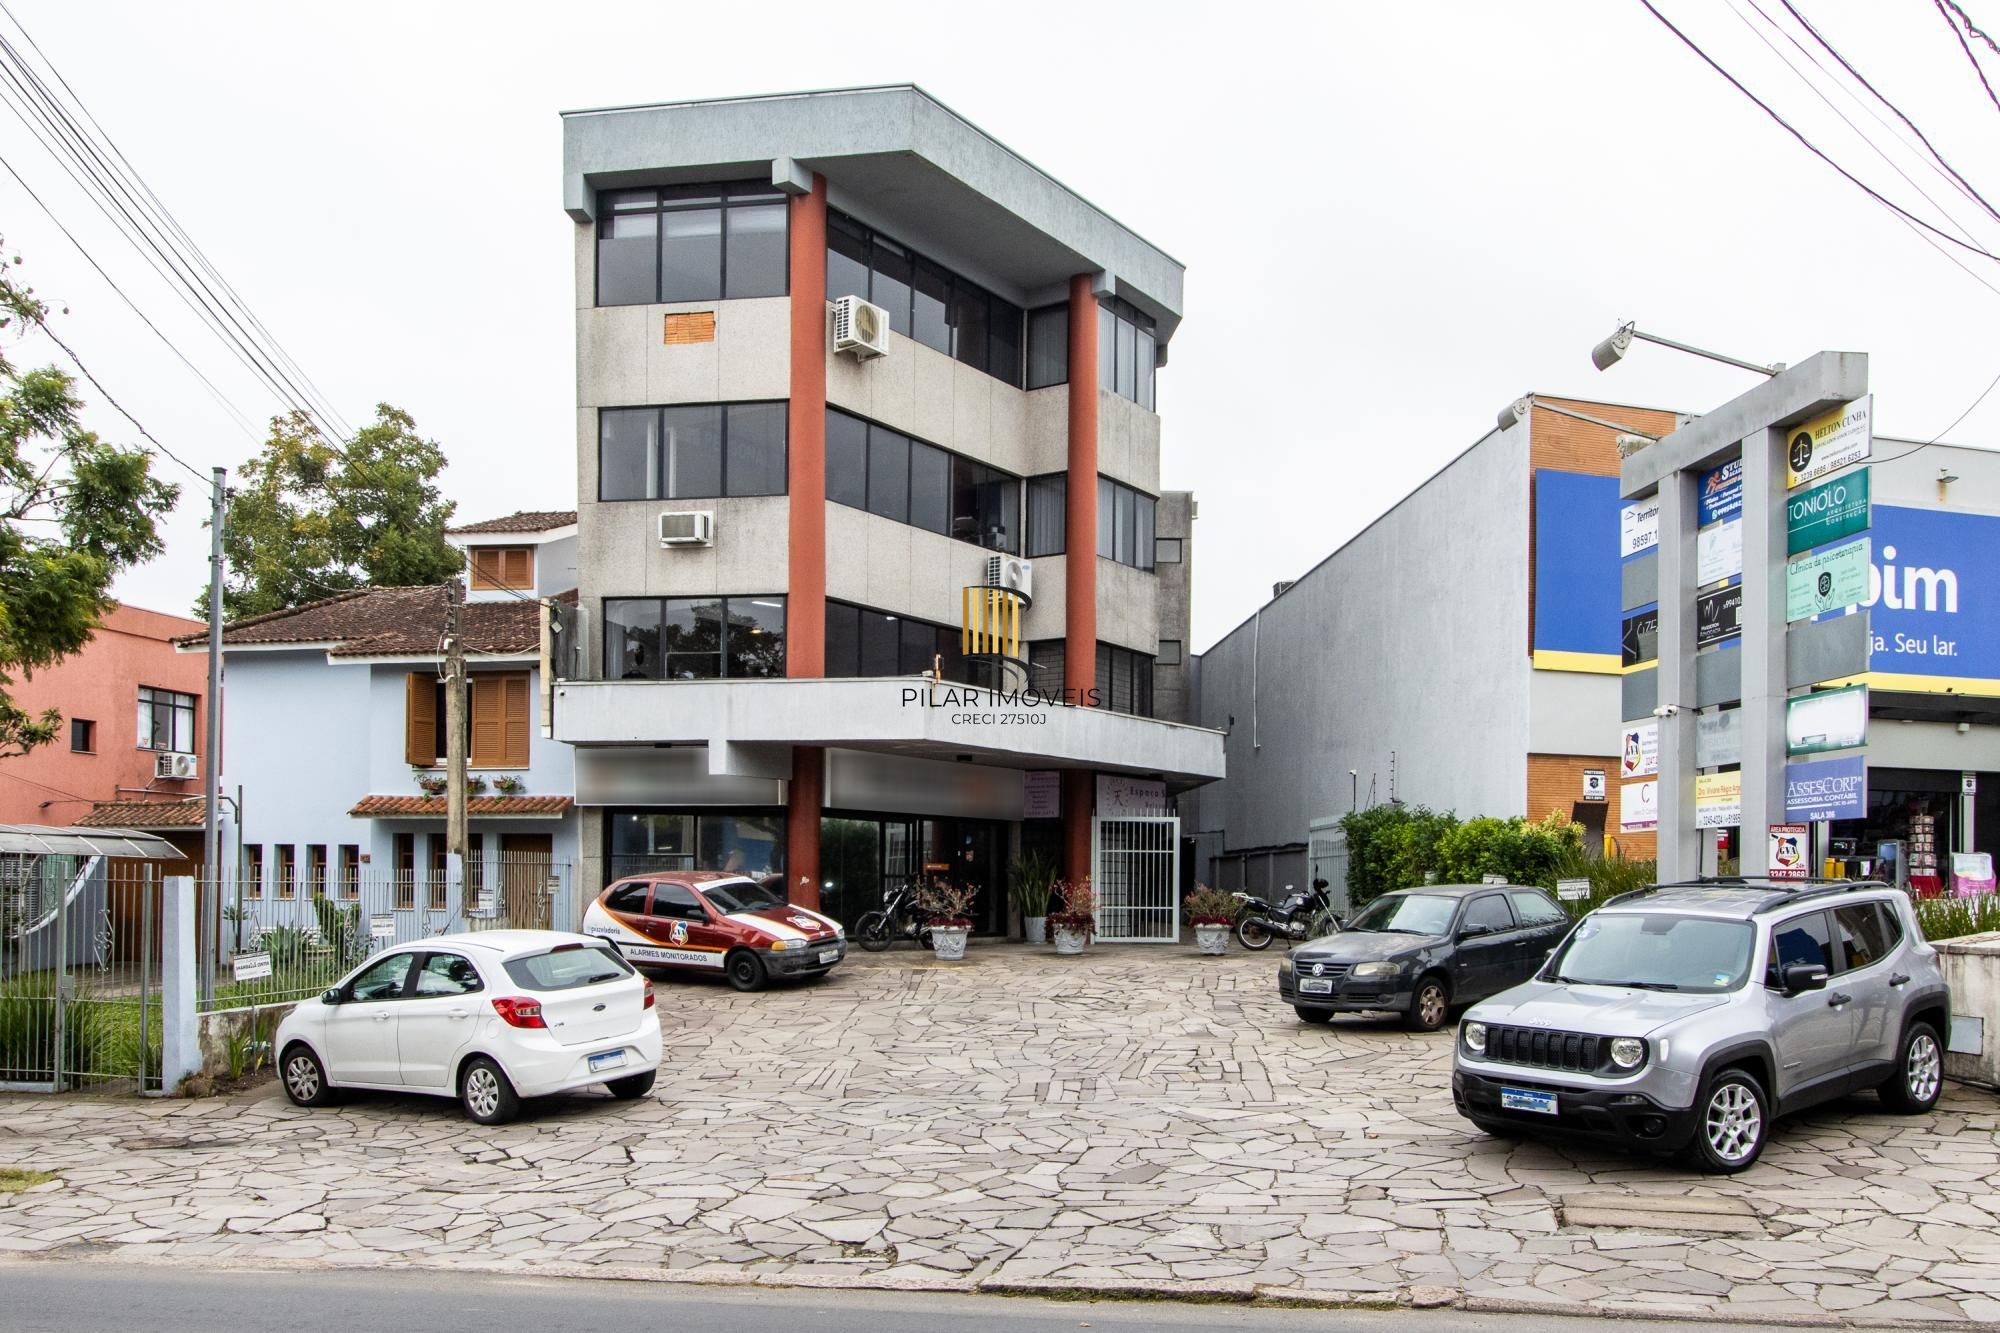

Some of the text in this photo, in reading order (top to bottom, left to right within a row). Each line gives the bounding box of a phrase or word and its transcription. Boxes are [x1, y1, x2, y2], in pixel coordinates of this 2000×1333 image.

[1815, 410, 1867, 440] HELTON CUNHA
[1826, 498, 1867, 516] ARQUITETURA
[1822, 543, 1864, 569] psicoterapia
[1895, 633, 1927, 655] Seu
[1933, 635, 1958, 657] lar.
[1786, 792, 1857, 805] ASSESSORIA CONTÁBIL
[1810, 811, 1825, 820] SALA
[1779, 846, 1796, 855] GVA
[630, 948, 708, 962] ALARMES MONITORADOS
